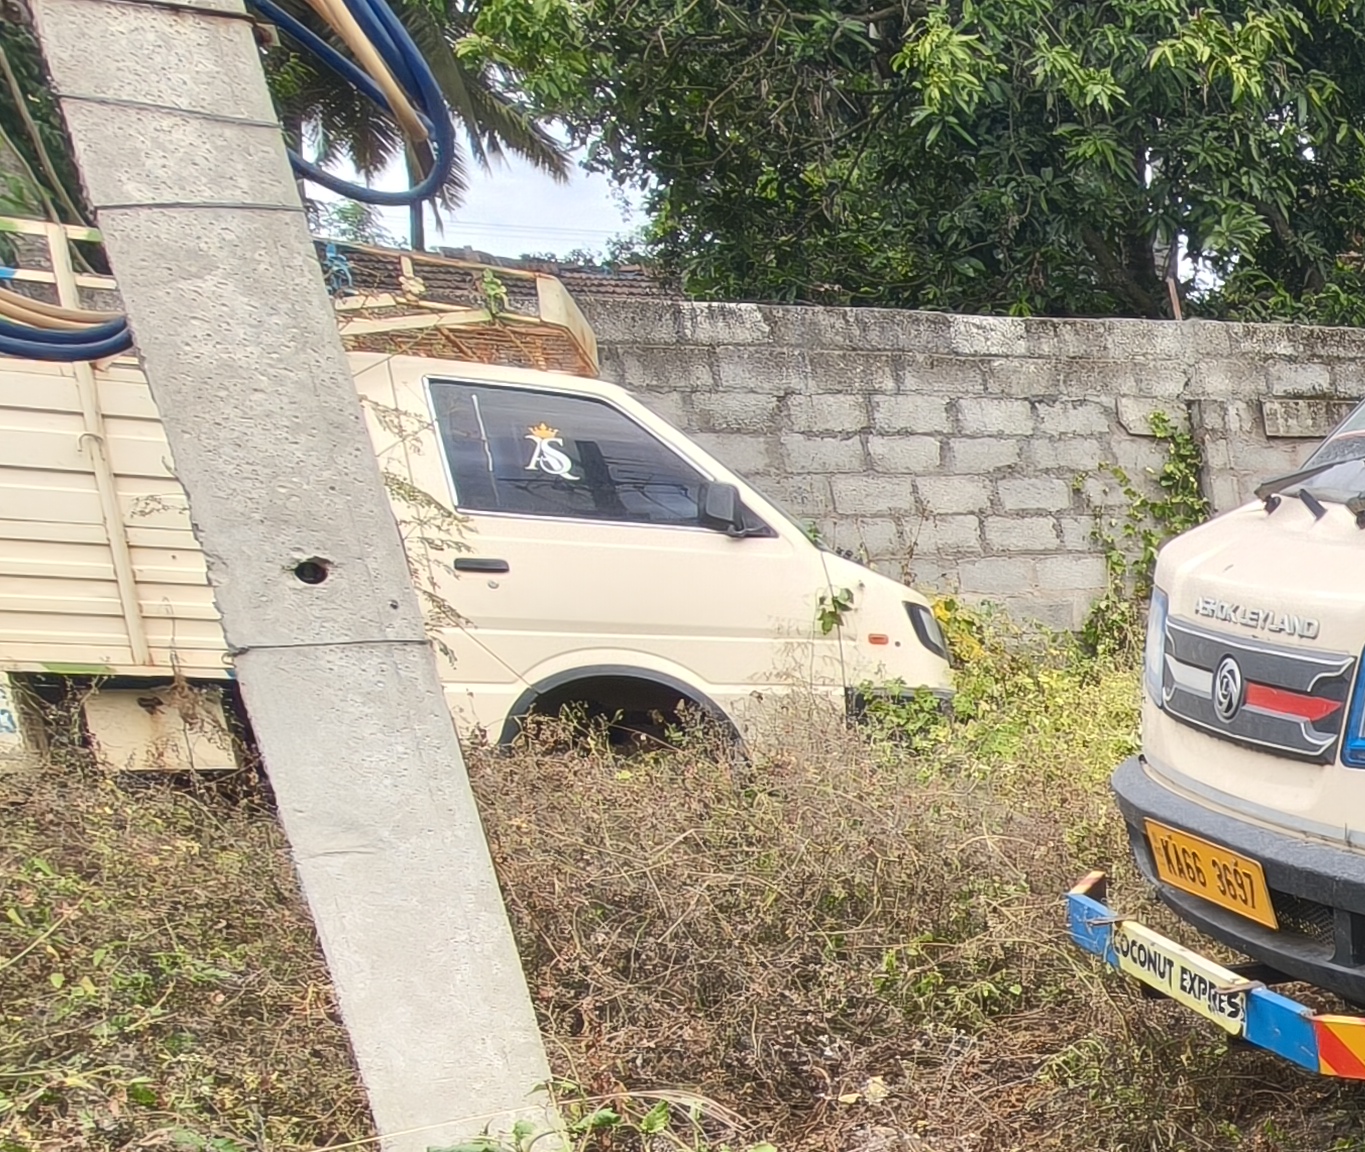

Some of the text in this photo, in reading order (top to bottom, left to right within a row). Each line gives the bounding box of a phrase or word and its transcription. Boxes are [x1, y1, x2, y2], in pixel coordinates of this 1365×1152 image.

[1239, 604, 1321, 640] LEYLAND
[1160, 836, 1207, 888] KA66
[1211, 858, 1256, 909] 3697
[1113, 929, 1175, 990] COCONUT
